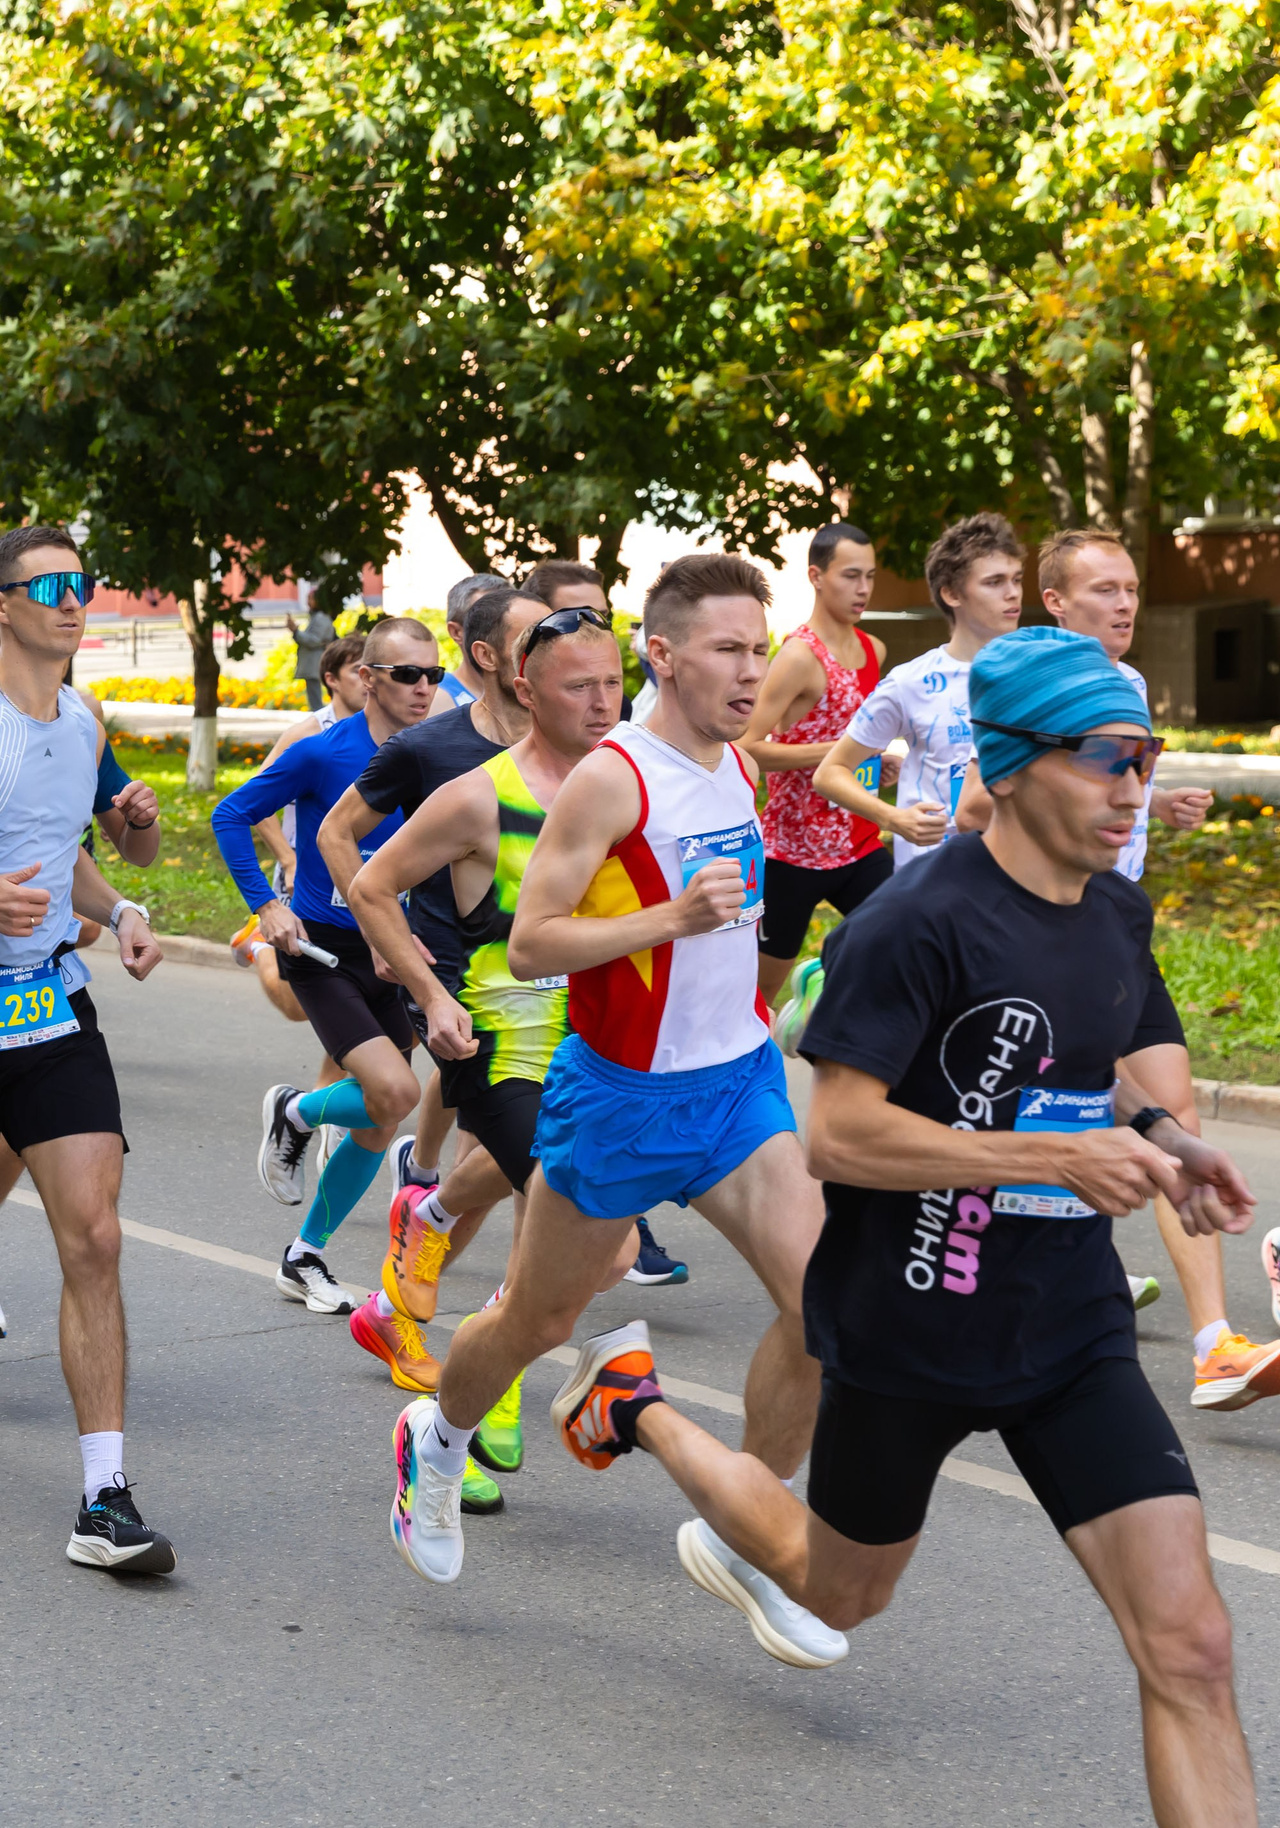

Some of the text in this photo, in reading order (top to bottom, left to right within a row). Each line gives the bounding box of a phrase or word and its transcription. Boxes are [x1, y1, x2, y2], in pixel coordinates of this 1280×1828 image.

[721, 840, 743, 852] МИЛЯ
[13, 972, 34, 983] МИЛЯ
[1078, 1107, 1105, 1119] МИЛЯ
